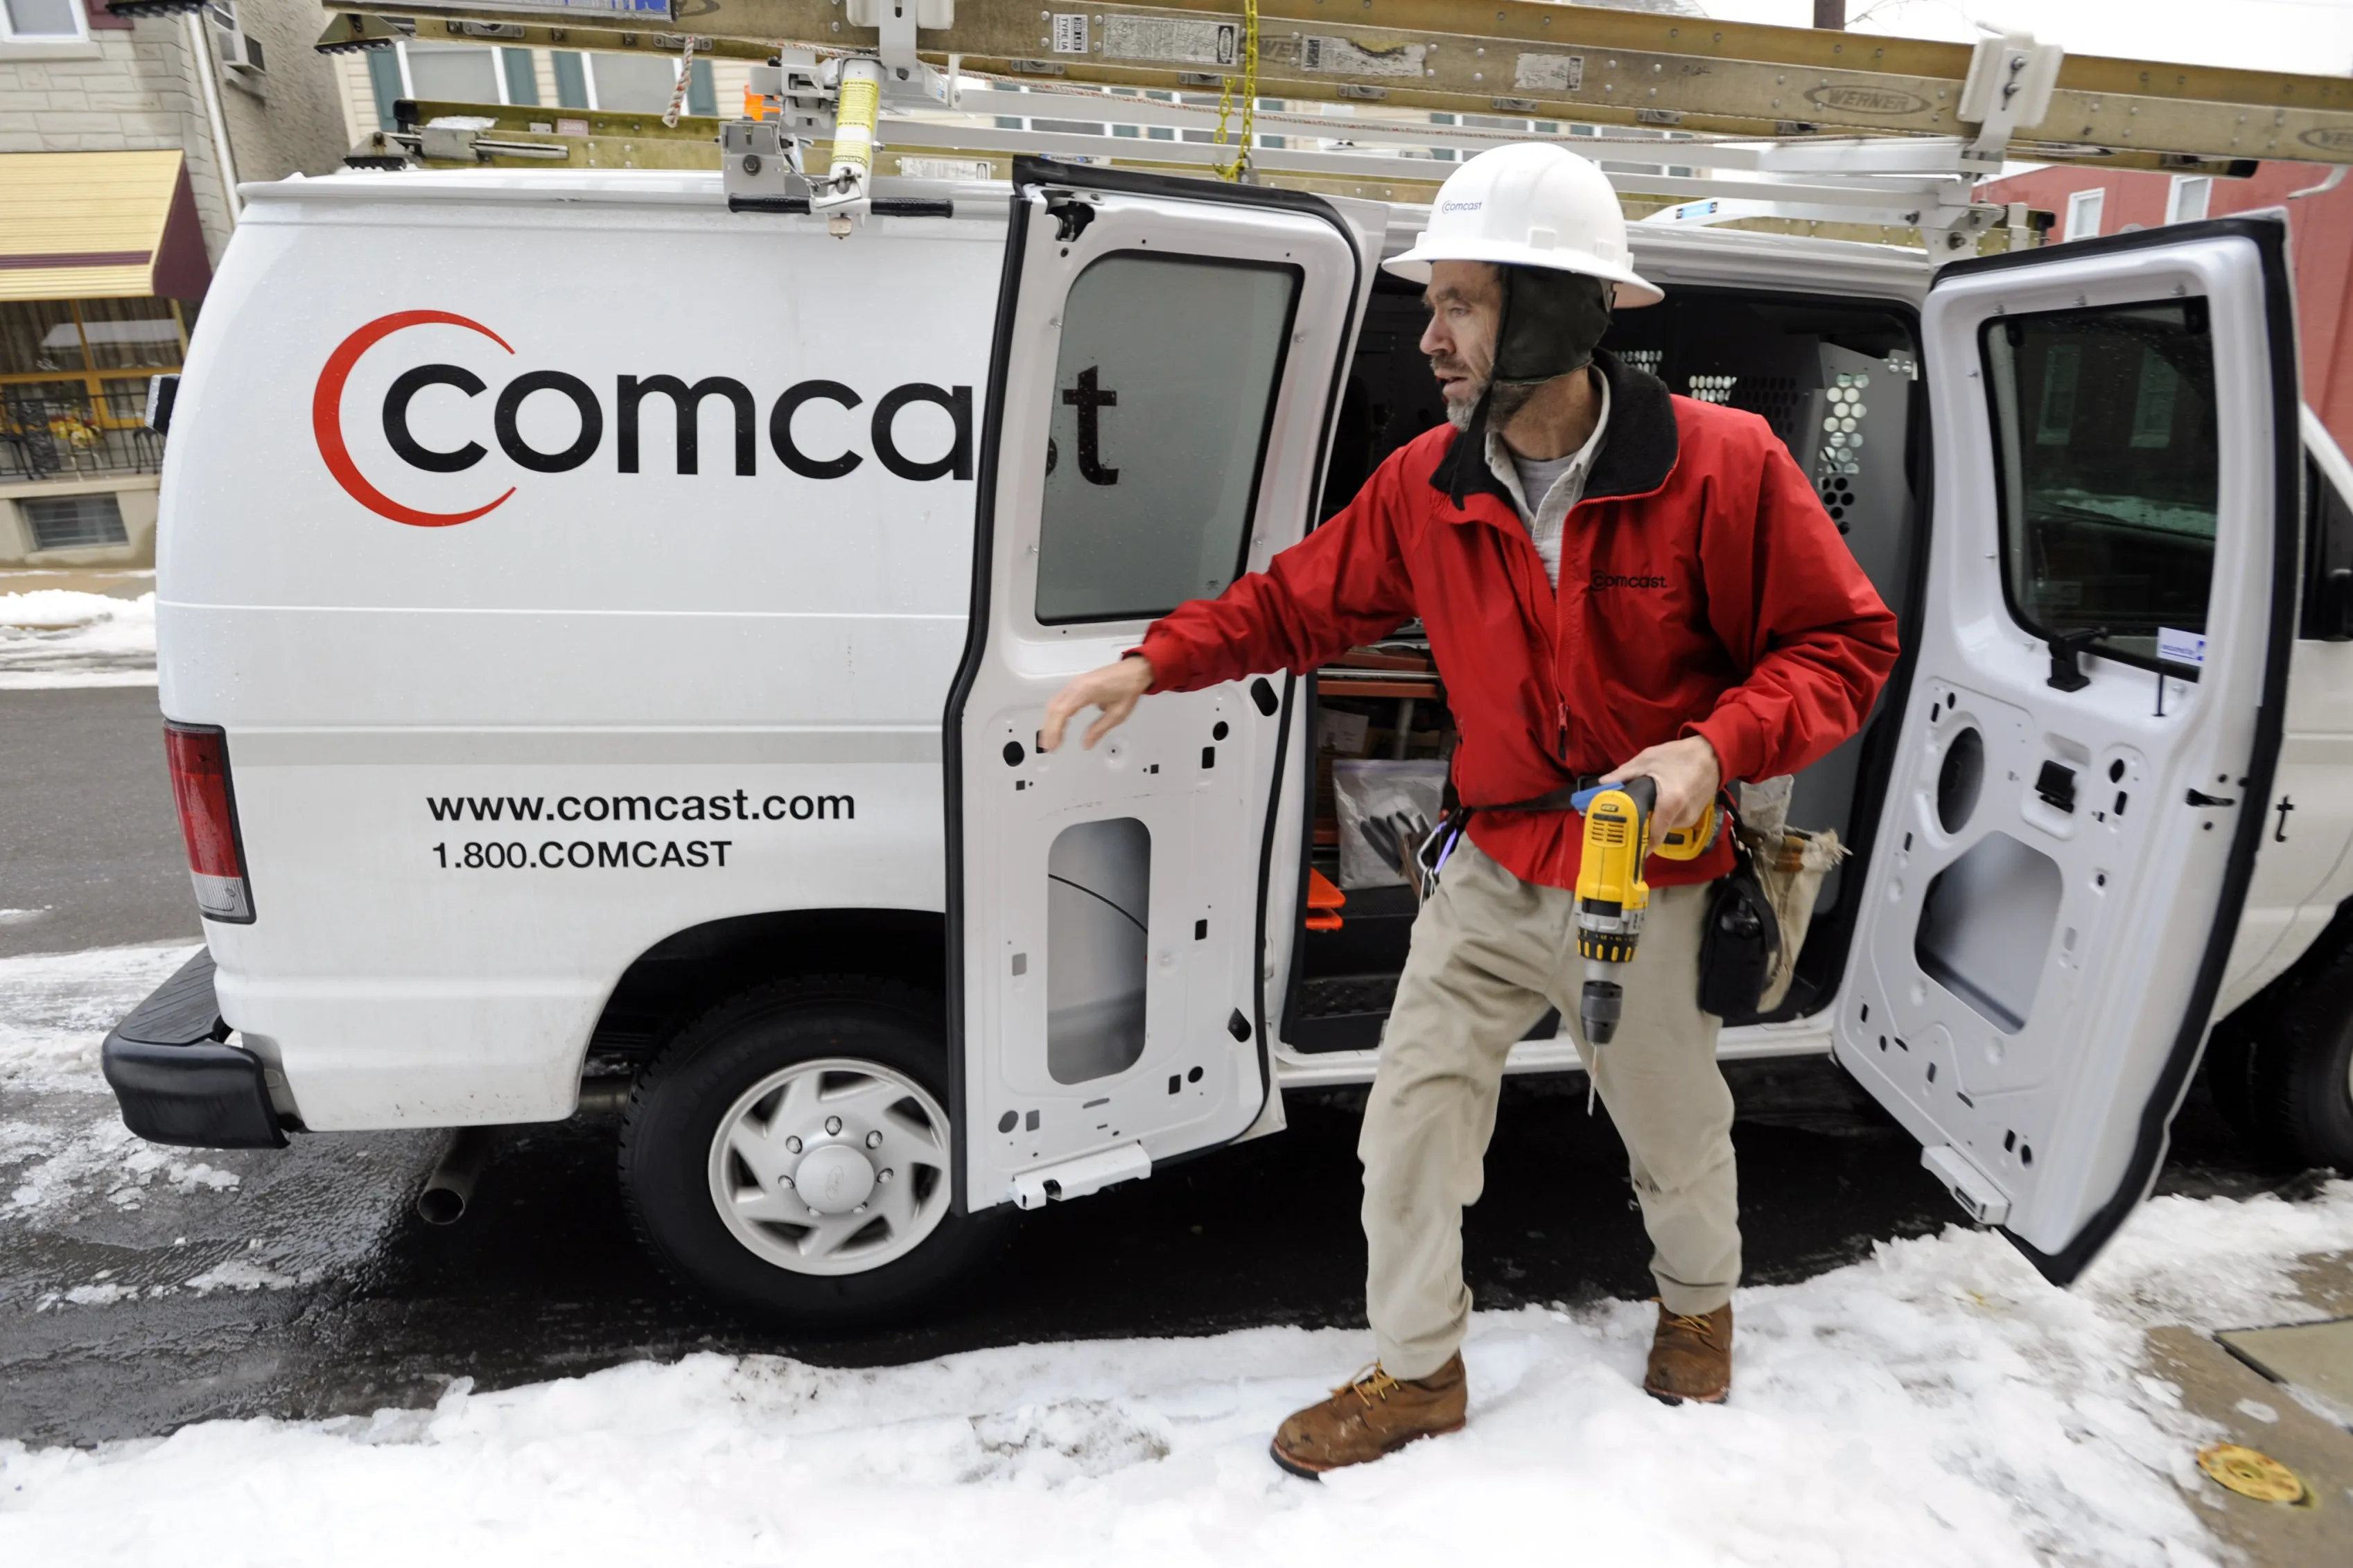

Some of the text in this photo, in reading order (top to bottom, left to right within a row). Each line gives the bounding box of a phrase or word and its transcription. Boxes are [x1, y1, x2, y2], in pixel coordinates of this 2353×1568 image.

[1828, 89, 1909, 111] WERNER
[1444, 200, 1482, 212] comcast
[426, 789, 856, 821] www.comcast.com
[432, 840, 733, 869] 1.800.COMCAST
